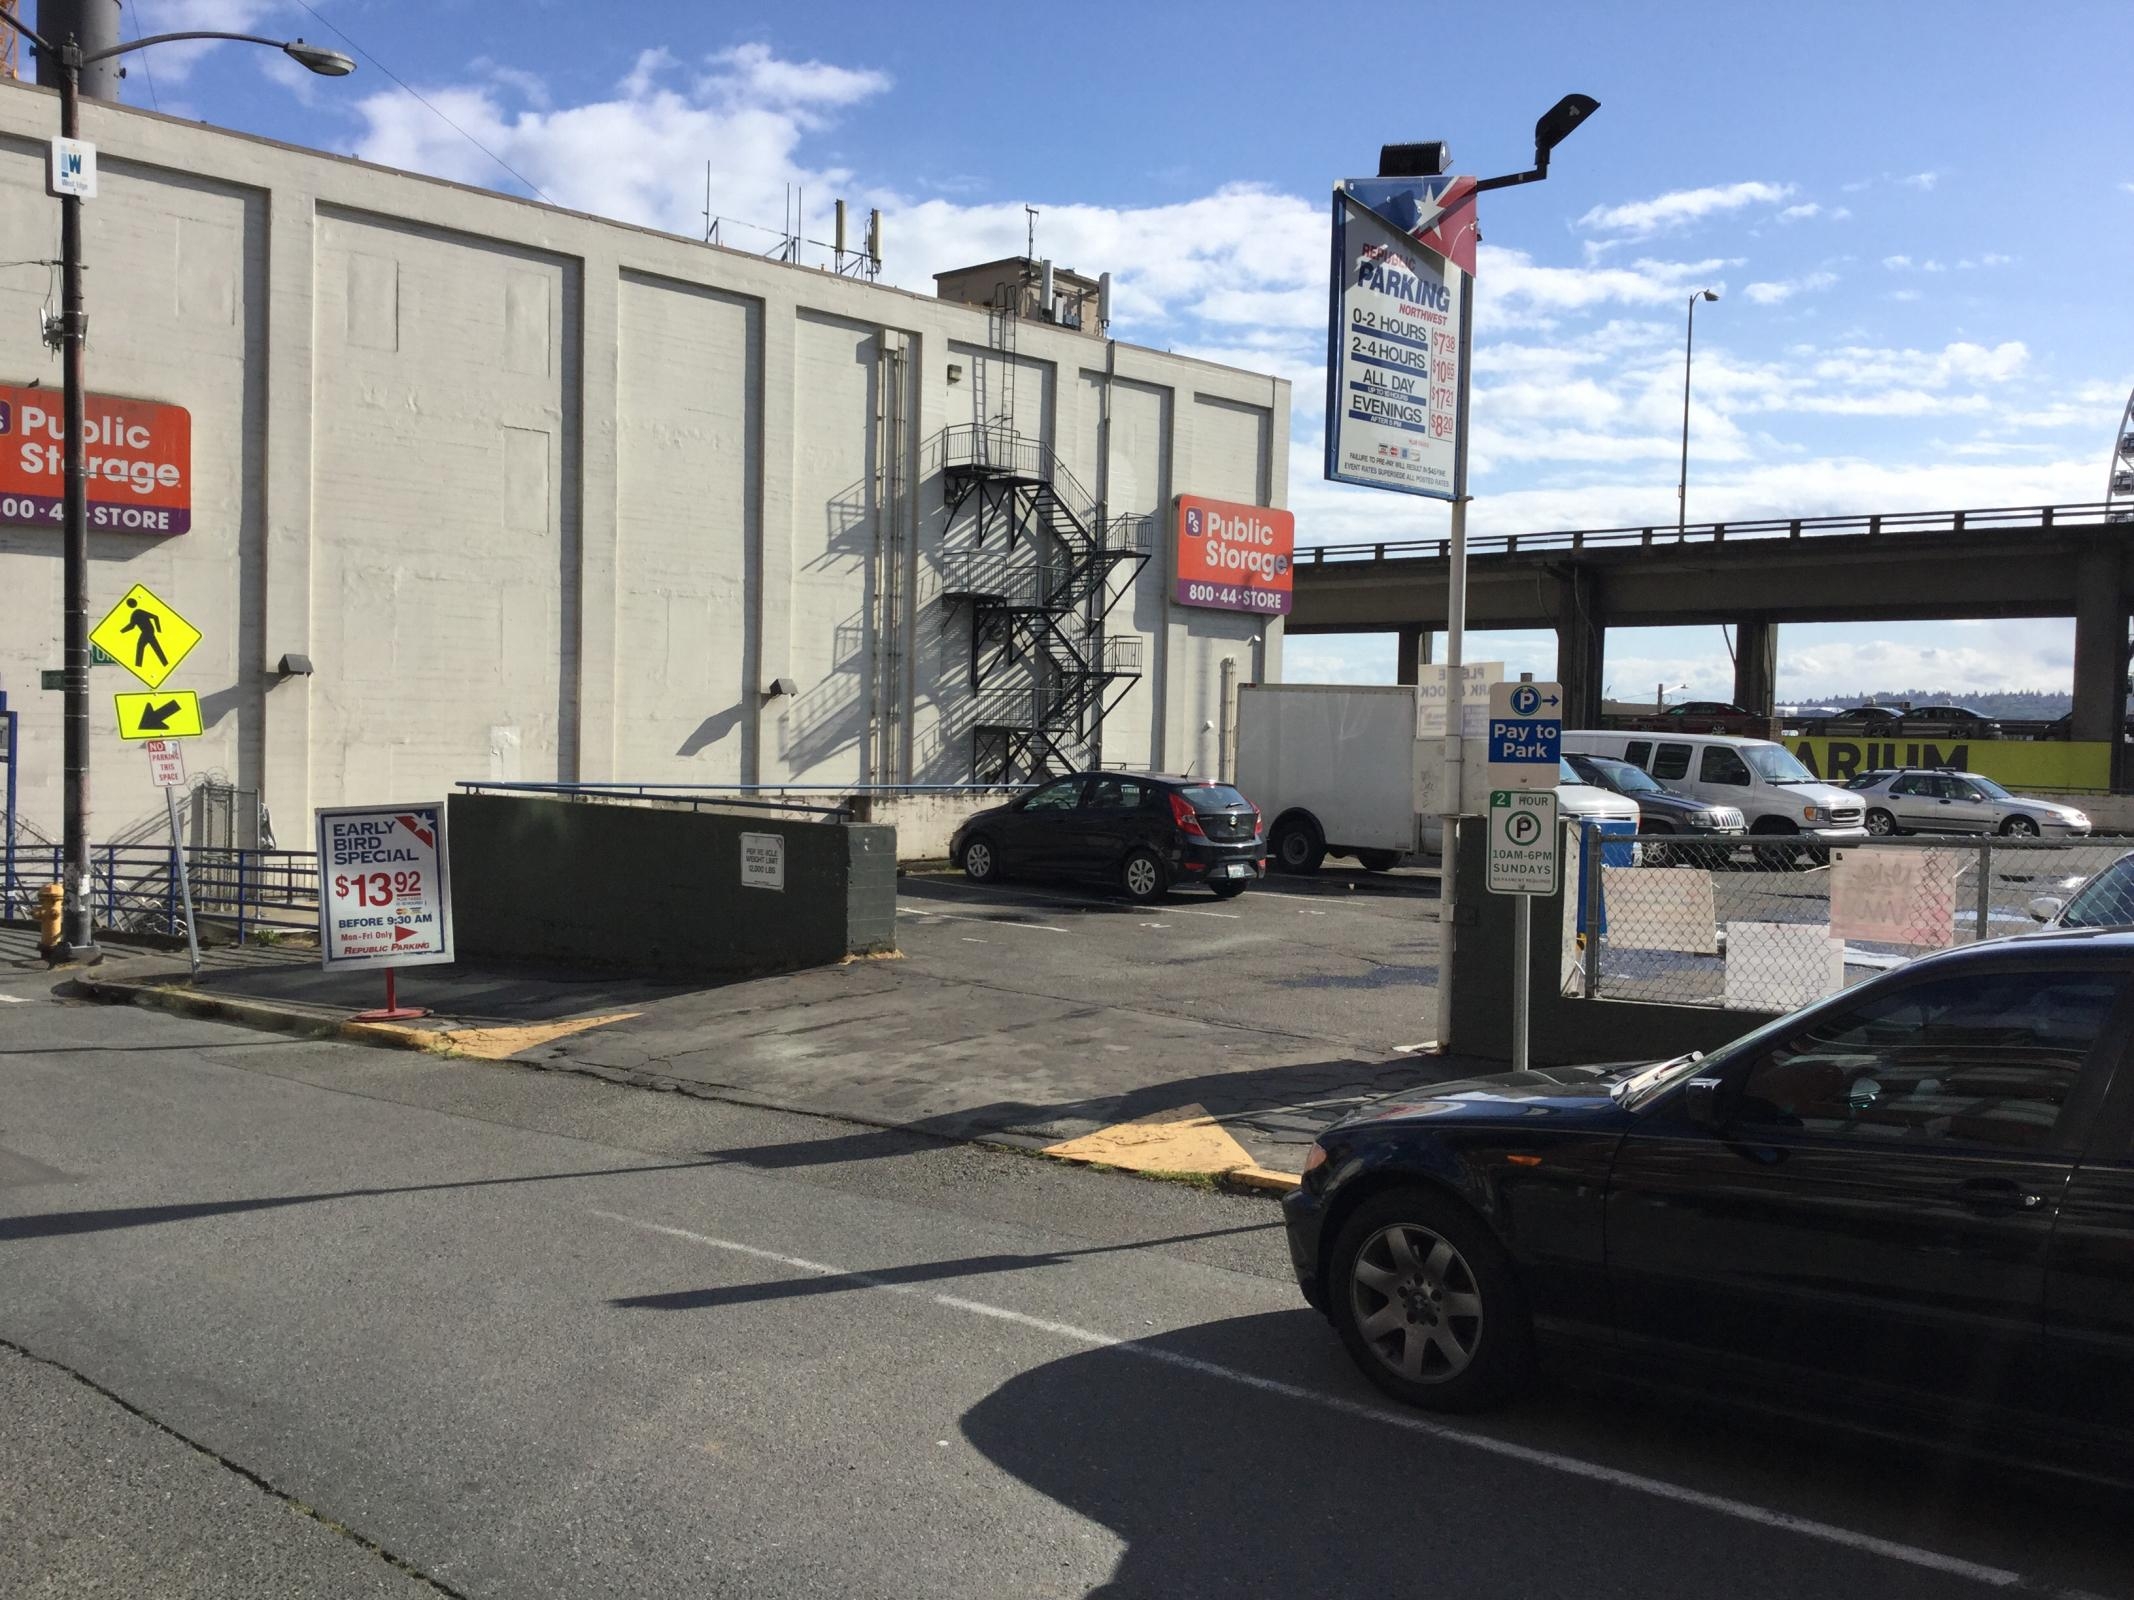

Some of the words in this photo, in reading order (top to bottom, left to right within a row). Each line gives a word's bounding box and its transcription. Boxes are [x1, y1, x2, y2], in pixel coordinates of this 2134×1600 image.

[1362, 243, 1416, 271] REPUBLIC
[1358, 261, 1450, 313] PARKING
[1399, 304, 1448, 325] NORTHWEST
[1353, 308, 1375, 327] 0-2
[1380, 316, 1426, 341] HOURS
[1379, 343, 1426, 369] HOURS
[1363, 369, 1387, 388] ALL
[1391, 375, 1415, 394] DAY
[1353, 394, 1422, 423] EVENINGS
[20, 442, 180, 494] Strage
[1207, 512, 1274, 546] Public
[1206, 540, 1288, 582] Storage
[1494, 723, 1529, 741] Pay
[1536, 724, 1557, 739] to
[150, 742, 163, 751] NO
[1503, 742, 1547, 758] Park
[152, 753, 179, 761] PARKING
[159, 773, 178, 781] SPACE
[1496, 792, 1506, 805] 2
[1519, 796, 1548, 806] HOUR
[333, 821, 396, 836] EARLY
[1517, 816, 1532, 838] P
[334, 836, 382, 851] BIRD
[334, 848, 419, 865] SPECIAL
[1493, 849, 1552, 860] 10AM-6PM
[1493, 863, 1551, 875] SUNDAYS
[338, 917, 383, 928] BEFORE
[387, 915, 411, 925] 9:30
[415, 913, 432, 923] AM
[375, 931, 393, 940] Only
[344, 945, 388, 954] REPUBLIC
[391, 941, 430, 951] PARKING
